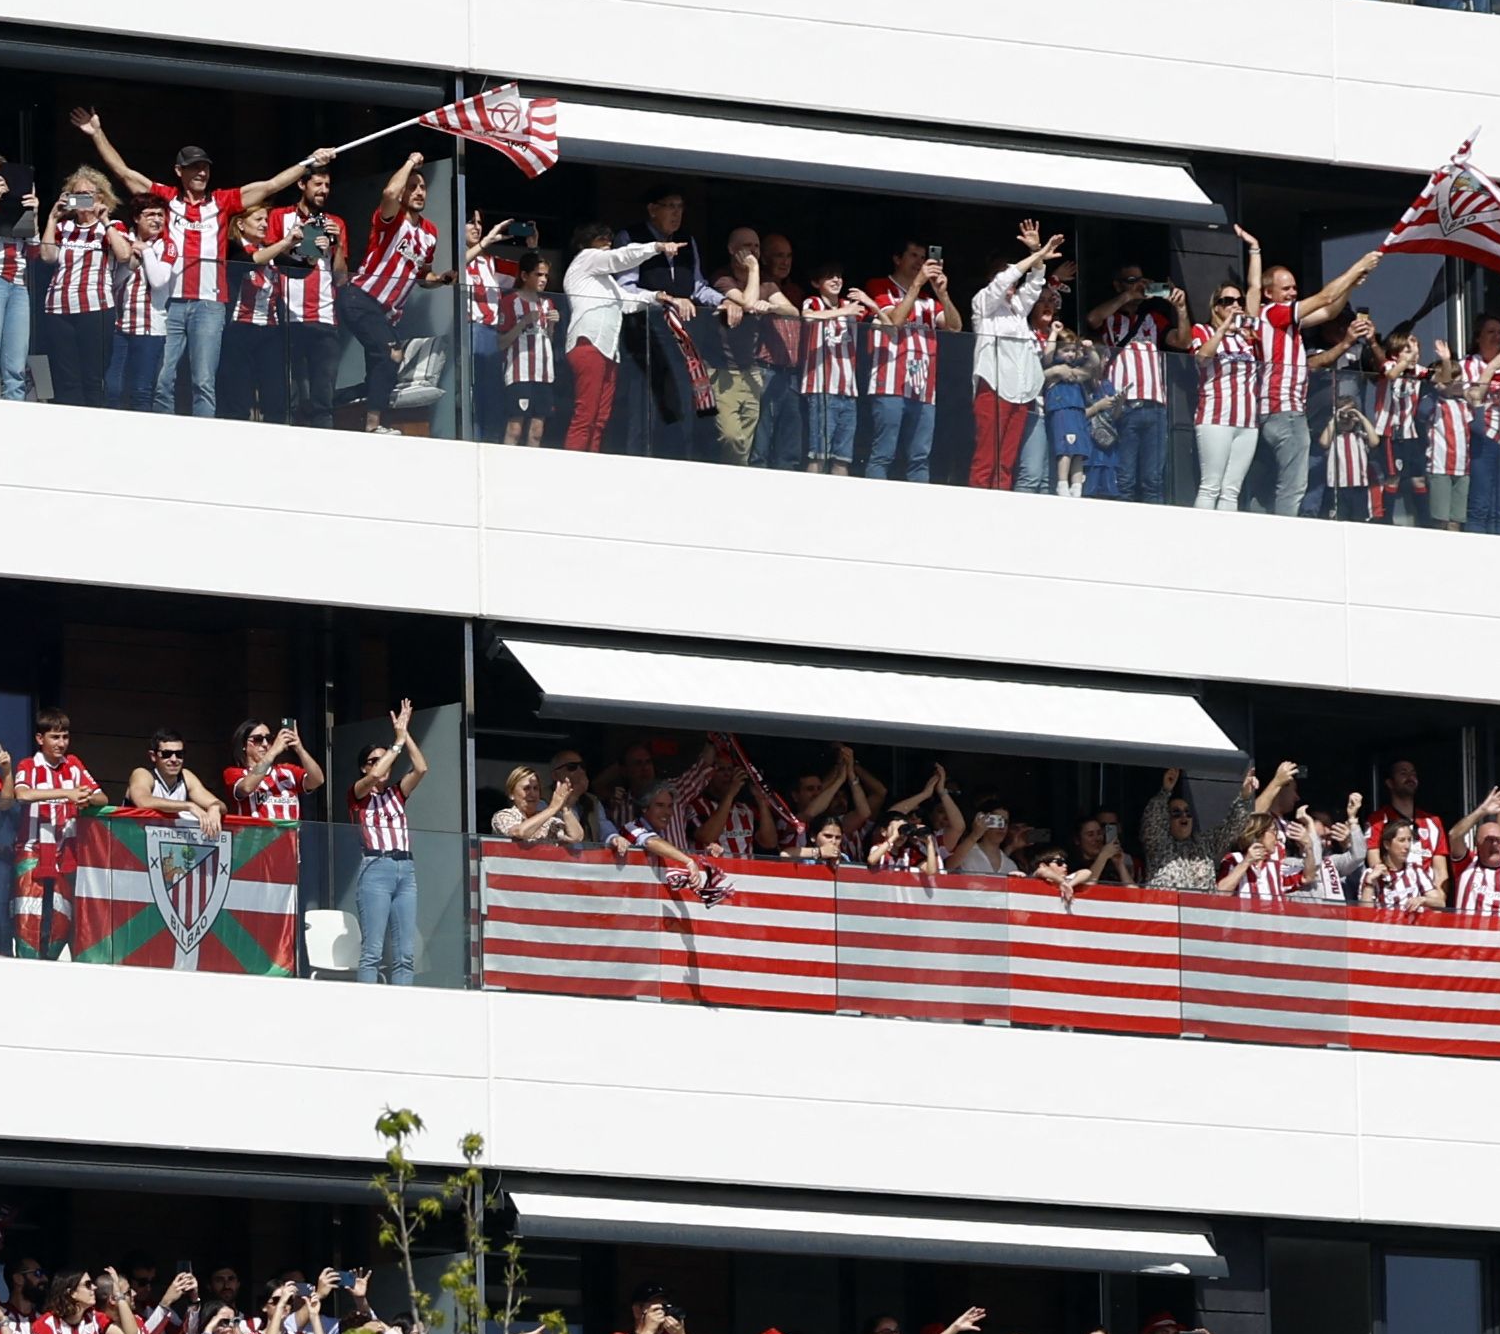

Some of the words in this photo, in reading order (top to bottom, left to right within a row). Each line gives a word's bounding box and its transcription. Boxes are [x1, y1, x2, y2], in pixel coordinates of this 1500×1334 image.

[150, 827, 195, 846] ATHLETIC
[199, 827, 228, 844] CLUB
[169, 916, 209, 950] BILBAO
